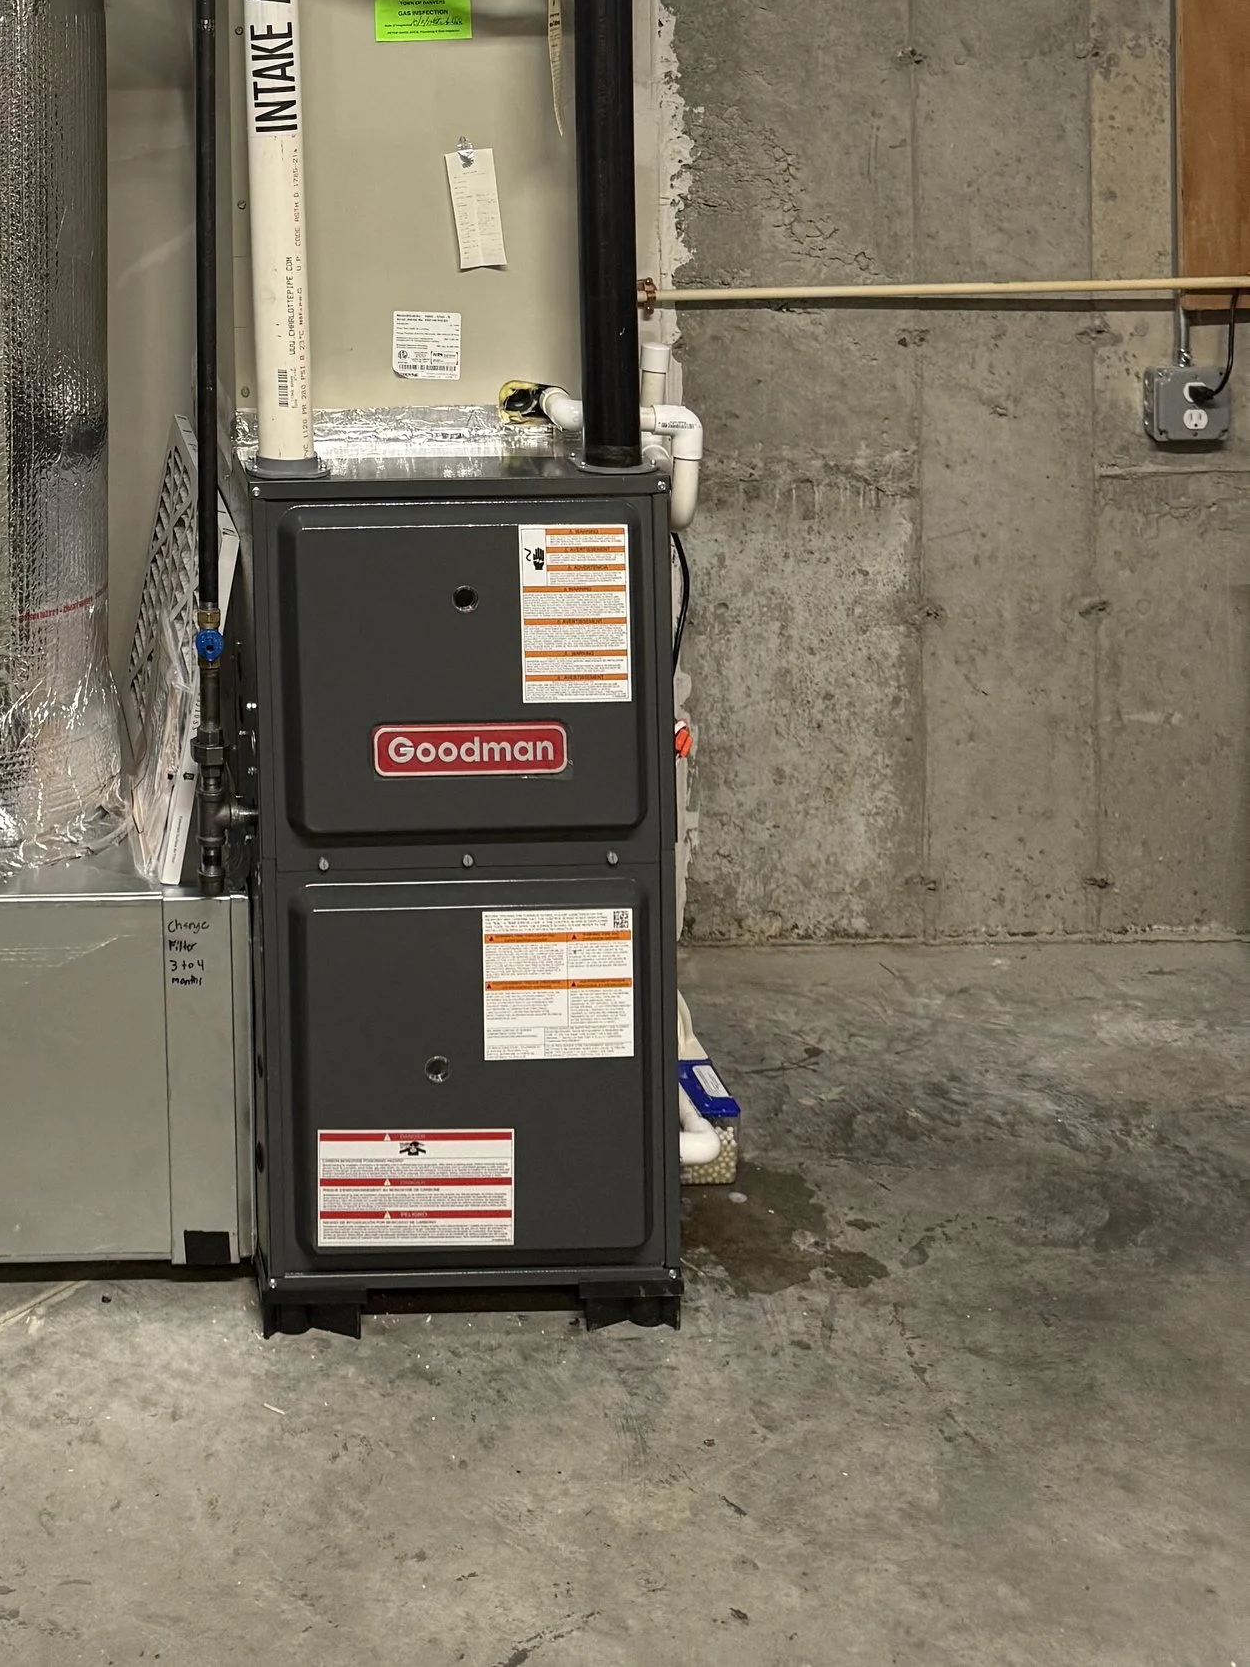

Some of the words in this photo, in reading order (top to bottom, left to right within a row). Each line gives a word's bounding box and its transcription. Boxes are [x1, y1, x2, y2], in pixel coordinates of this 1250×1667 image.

[250, 21, 298, 133] INTAKE
[388, 736, 554, 763] Goodman
[167, 919, 210, 934] Change
[169, 959, 178, 972] 3
[181, 960, 194, 970] to
[197, 959, 205, 971] 4
